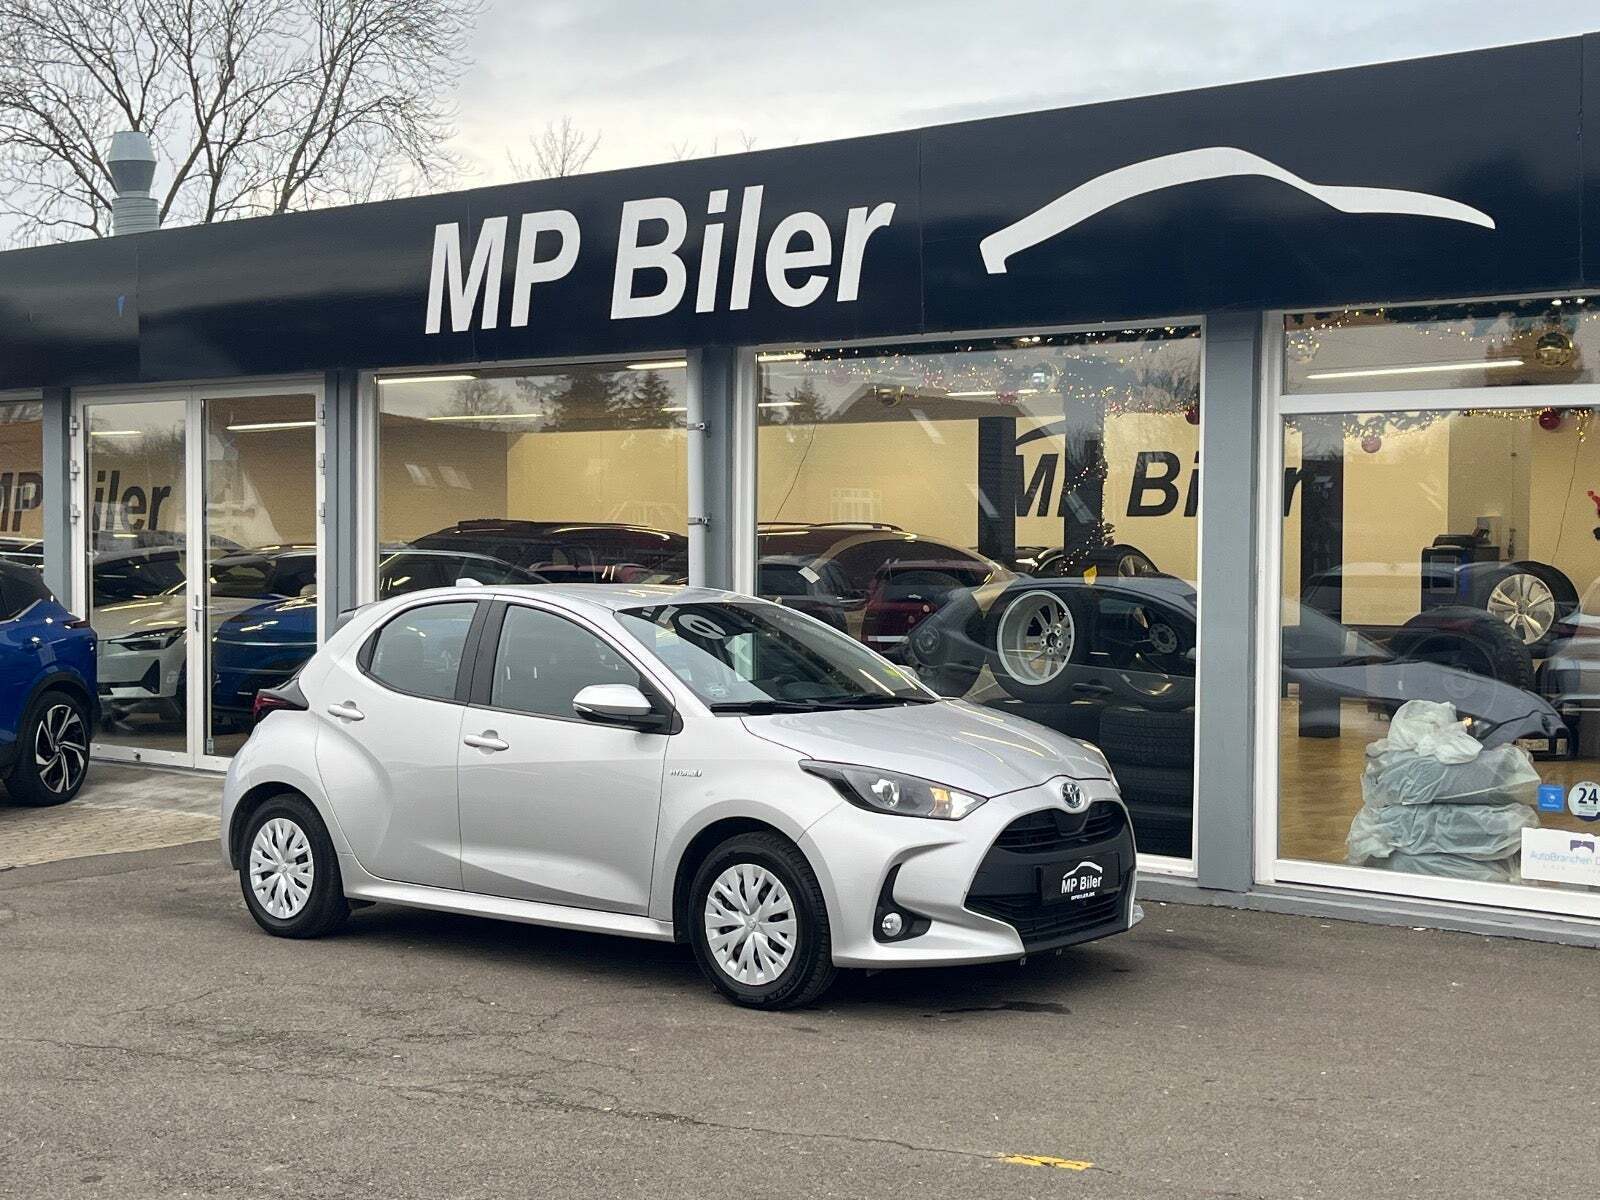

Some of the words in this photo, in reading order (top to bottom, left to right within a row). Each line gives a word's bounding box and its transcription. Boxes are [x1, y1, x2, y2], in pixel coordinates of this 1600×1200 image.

[425, 210, 581, 335] MP
[610, 185, 896, 320] Biler
[92, 470, 172, 531] iler
[1578, 787, 1599, 805] 24
[1061, 878, 1078, 894] MP
[1079, 874, 1103, 891] Biler
